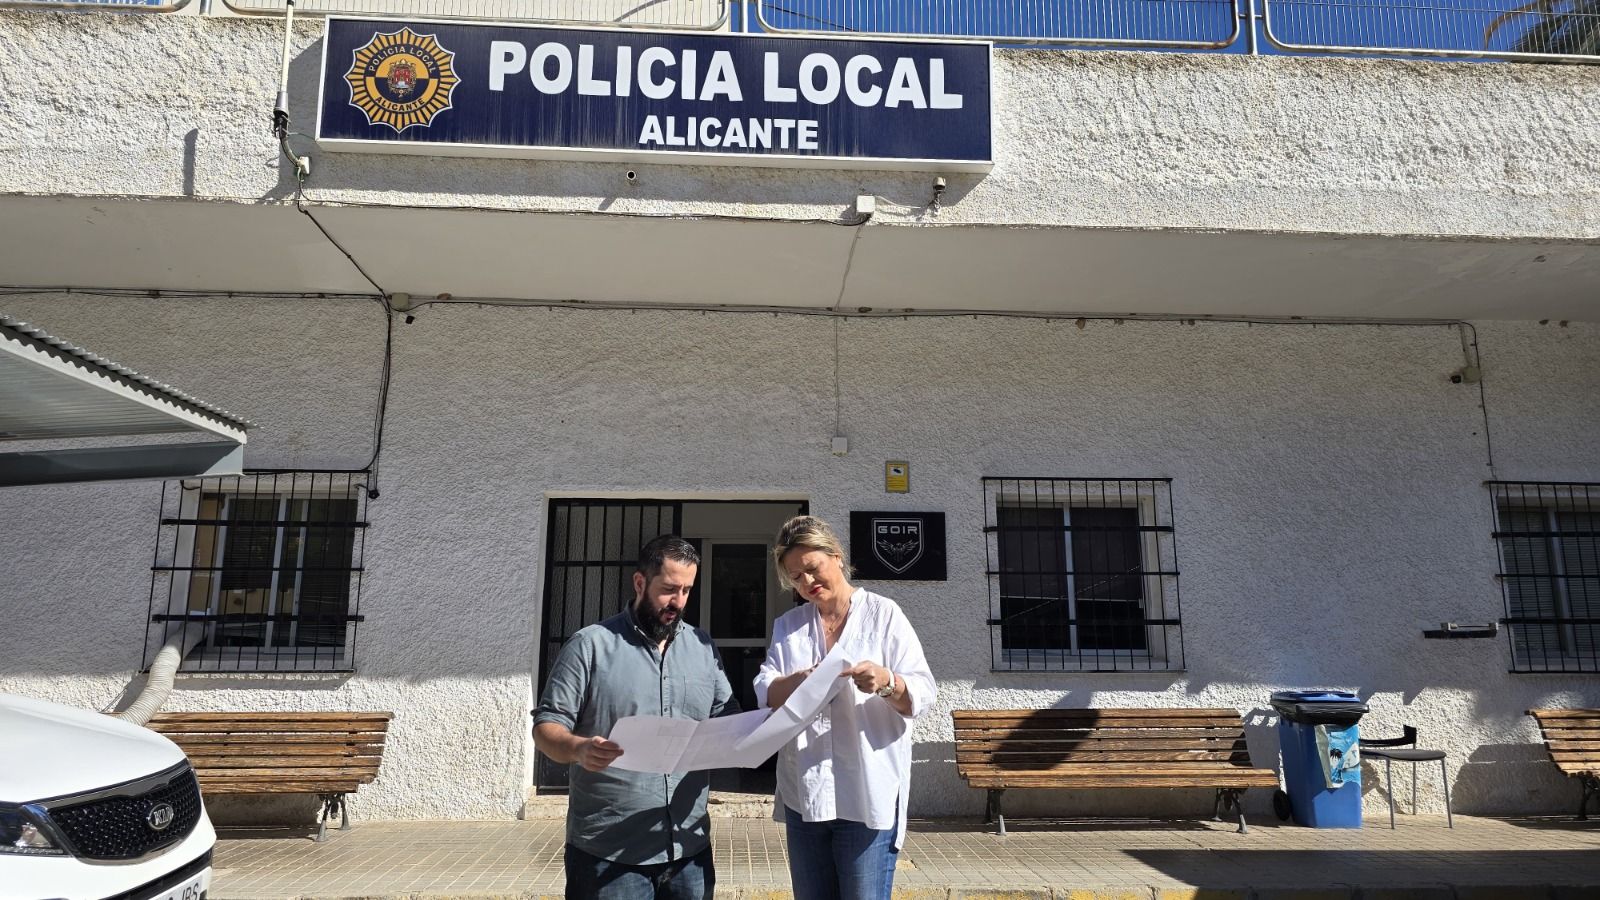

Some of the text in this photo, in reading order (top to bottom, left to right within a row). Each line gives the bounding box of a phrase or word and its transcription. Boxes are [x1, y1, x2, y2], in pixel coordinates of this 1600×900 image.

[369, 46, 437, 73] POLICIA LOCAL
[489, 40, 963, 110] POLICIA LOCAL
[375, 96, 425, 112] ALICANTE
[639, 115, 819, 150] ALICANTE
[877, 525, 918, 535] GOIR
